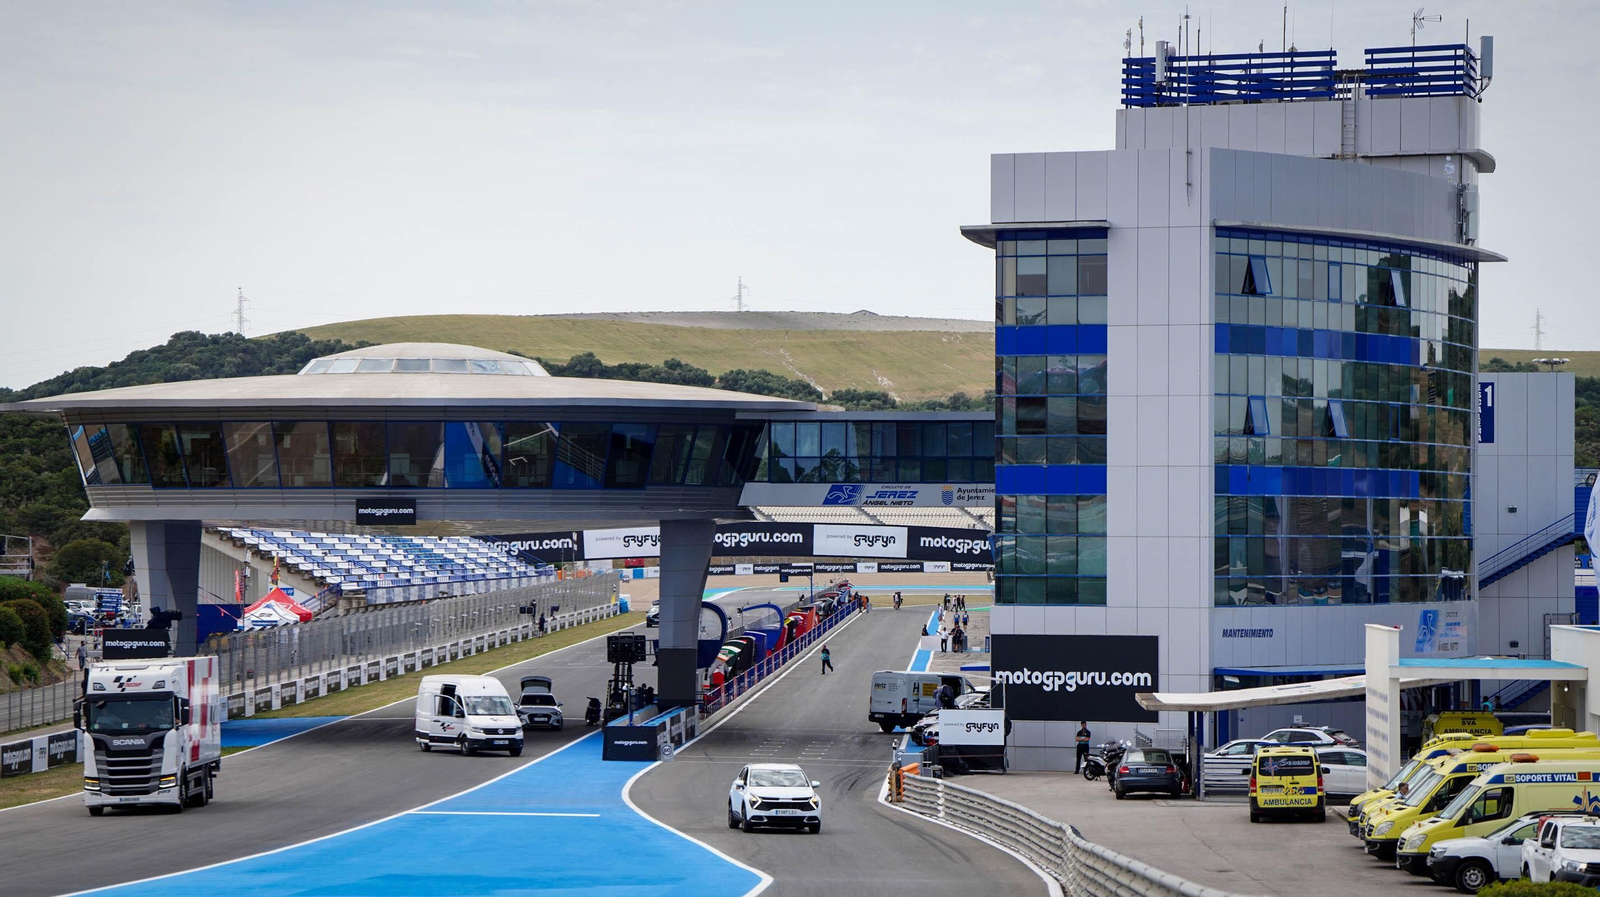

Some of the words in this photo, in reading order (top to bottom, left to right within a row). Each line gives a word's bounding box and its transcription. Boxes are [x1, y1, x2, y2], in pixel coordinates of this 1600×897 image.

[1484, 385, 1493, 407] 1
[866, 490, 919, 499] JEREZ
[956, 487, 995, 495] Ayuntamie
[358, 508, 414, 516] motogpguru.com
[714, 532, 803, 547] ogpguru.com
[1222, 628, 1274, 638] MANTENIMIENTO
[105, 639, 166, 649] motogpguru.com
[995, 667, 1152, 692] motogpguru.com
[1515, 774, 1552, 782] SOPORTE
[1554, 773, 1577, 782] VITAL
[1263, 798, 1313, 806] AMBULANCIA
